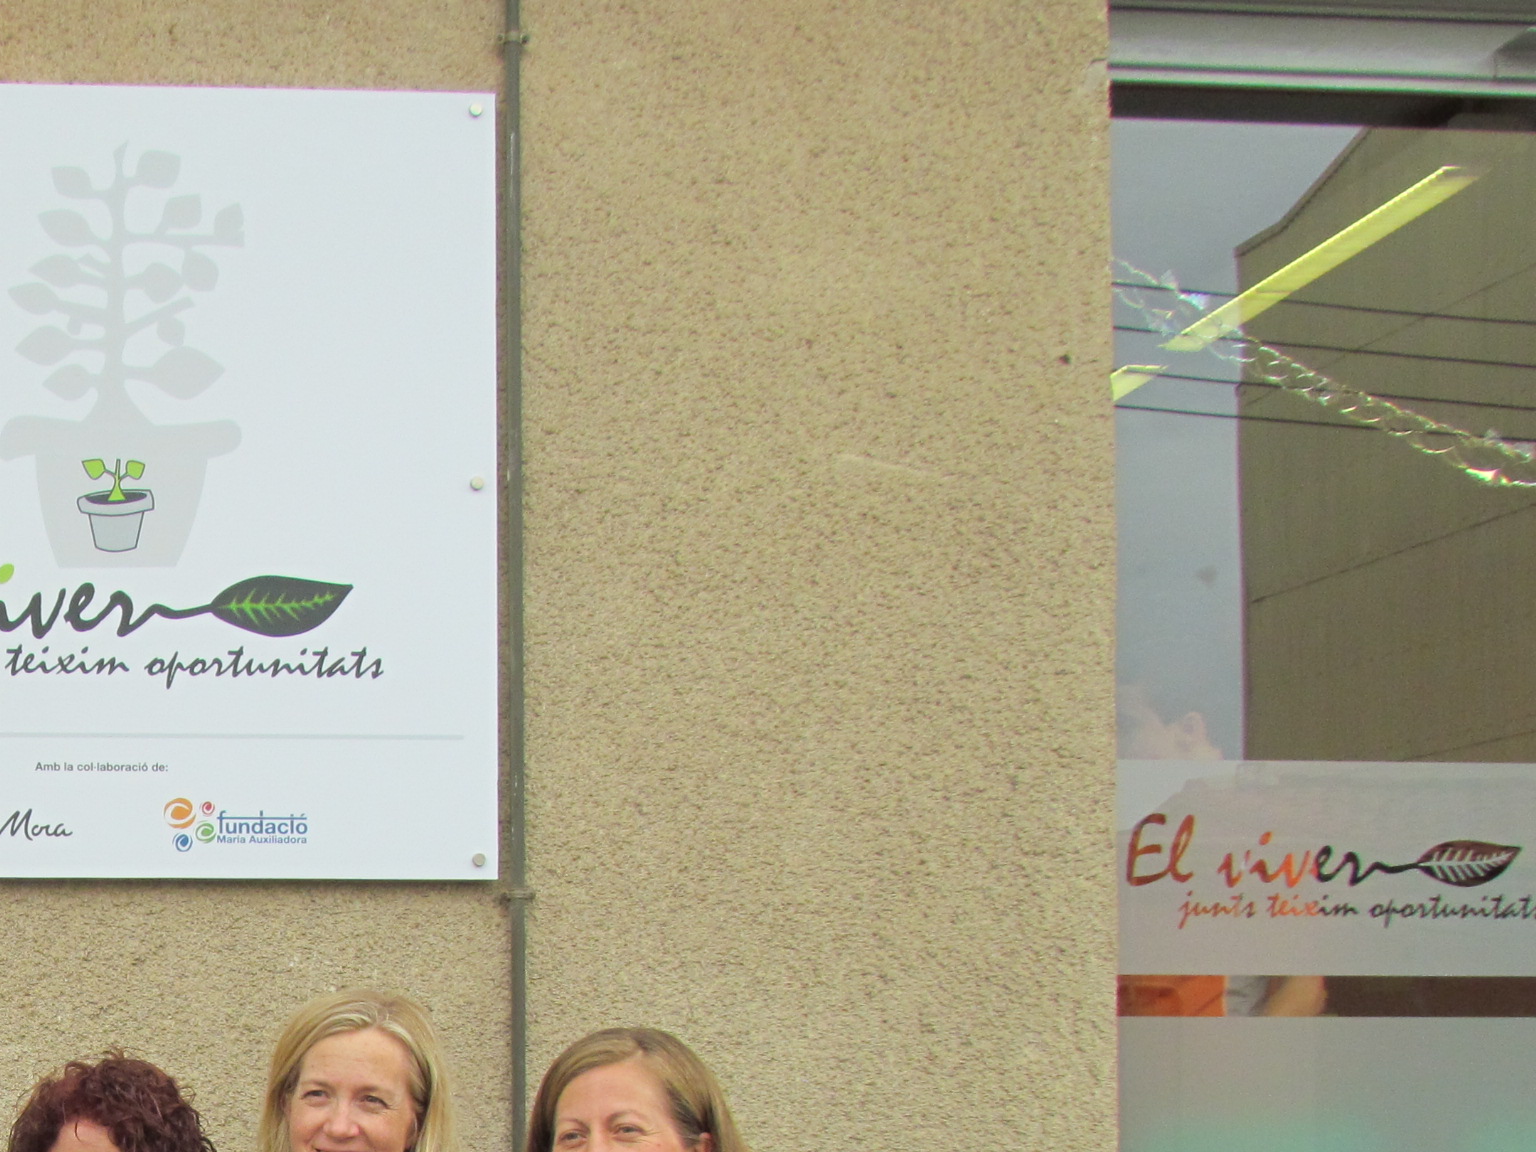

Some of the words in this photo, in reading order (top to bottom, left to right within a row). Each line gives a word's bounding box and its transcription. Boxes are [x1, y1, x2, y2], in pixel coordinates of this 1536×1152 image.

[4, 646, 130, 678] teixim
[144, 646, 384, 689] oportunitats
[35, 762, 61, 772] Amb
[64, 762, 74, 772] la
[77, 762, 149, 772] col·laboració
[152, 762, 169, 773] de:
[217, 810, 308, 834] fundació
[249, 835, 307, 844] Auxiliadora
[1126, 813, 1195, 887] El
[1178, 891, 1256, 930] junts
[1267, 894, 1358, 919] teixim
[1368, 894, 1536, 929] oportunitat
